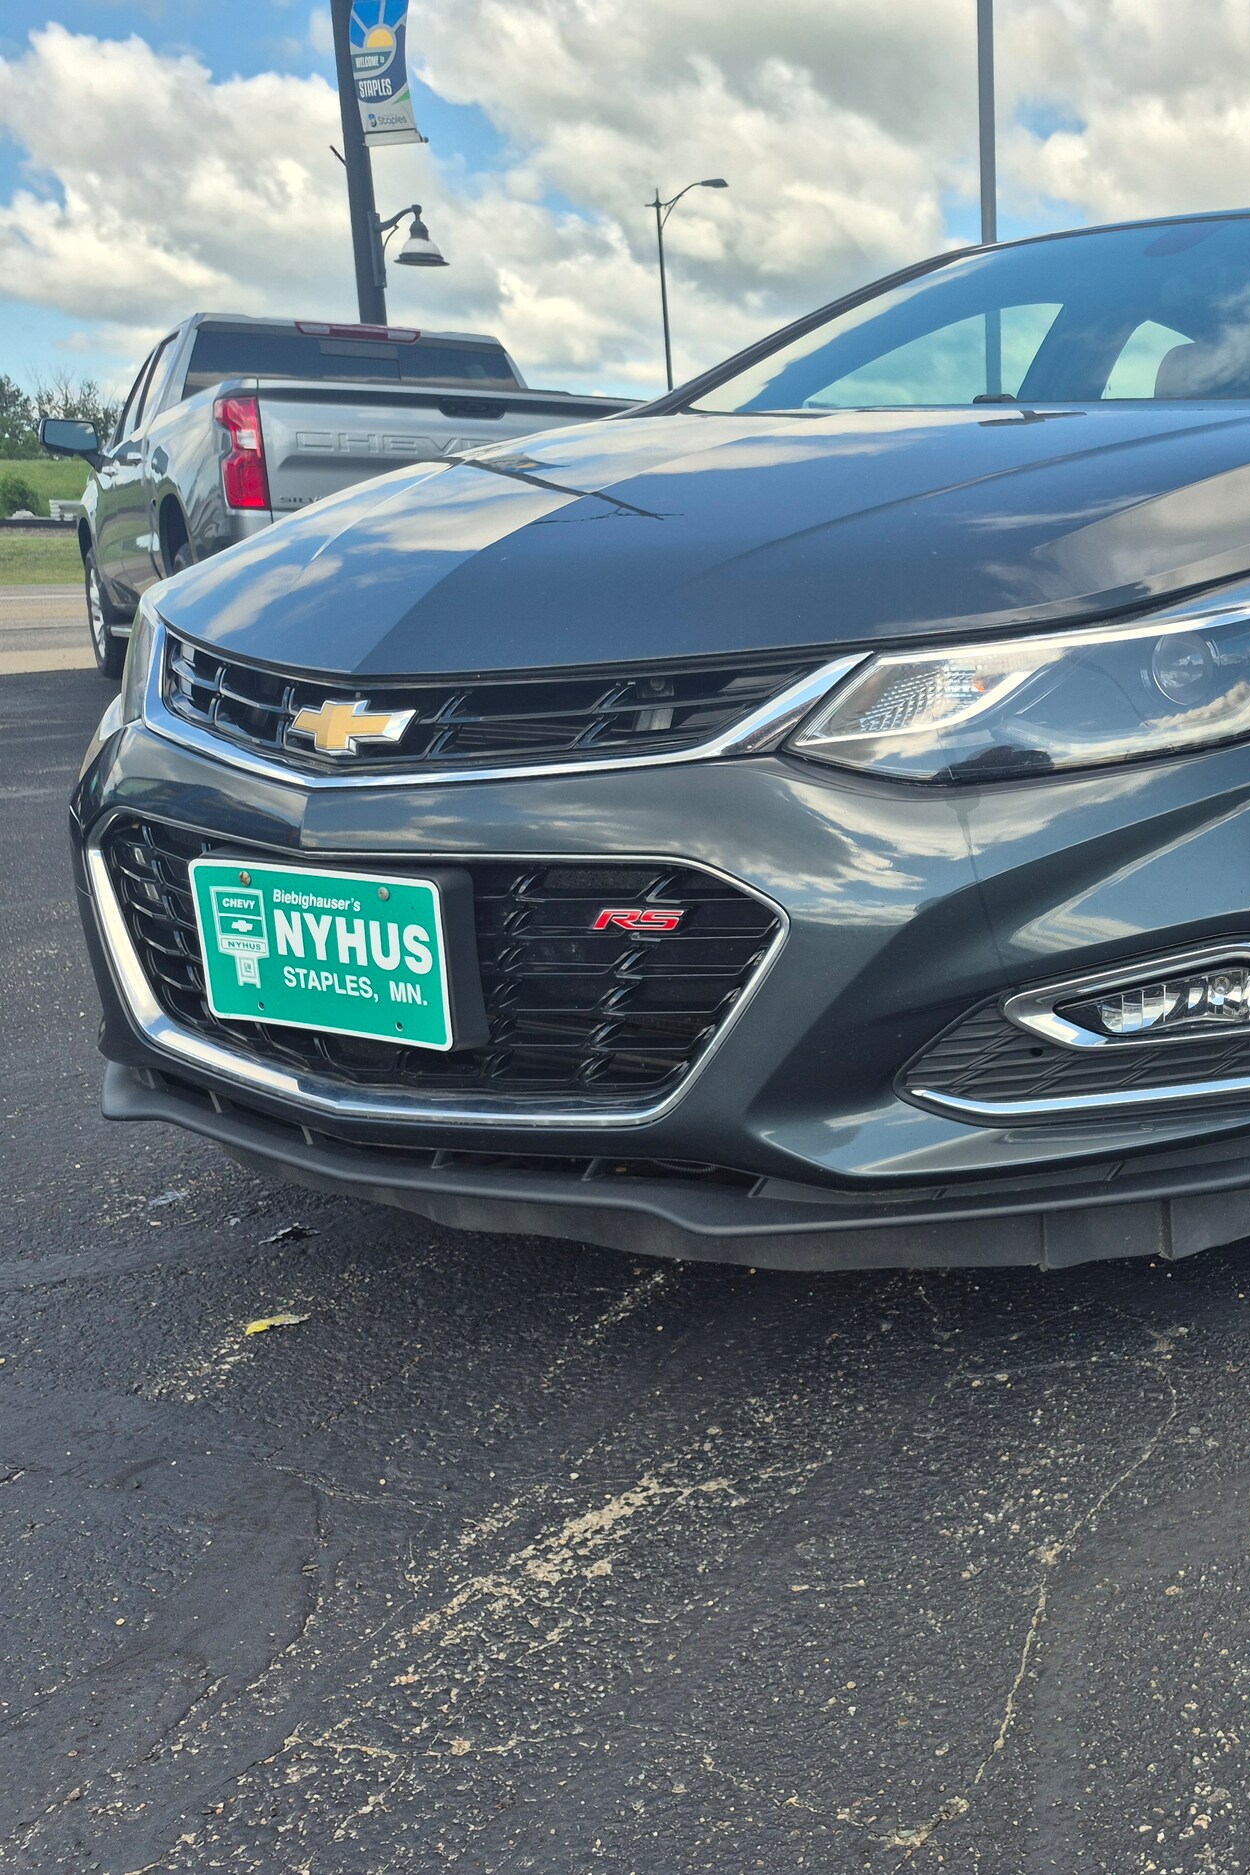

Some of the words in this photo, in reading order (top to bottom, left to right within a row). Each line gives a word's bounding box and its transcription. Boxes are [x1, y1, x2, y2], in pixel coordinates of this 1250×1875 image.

[355, 55, 379, 68] WELCOME
[358, 78, 393, 98] STAPLES
[222, 898, 255, 910] CHEVY
[273, 888, 361, 912] Biebighauser's
[592, 908, 685, 931] RS
[227, 941, 261, 951] NYHUS
[273, 909, 433, 975] NYHUS
[283, 966, 379, 1003] STAPLES,
[389, 981, 428, 1006] MN.
